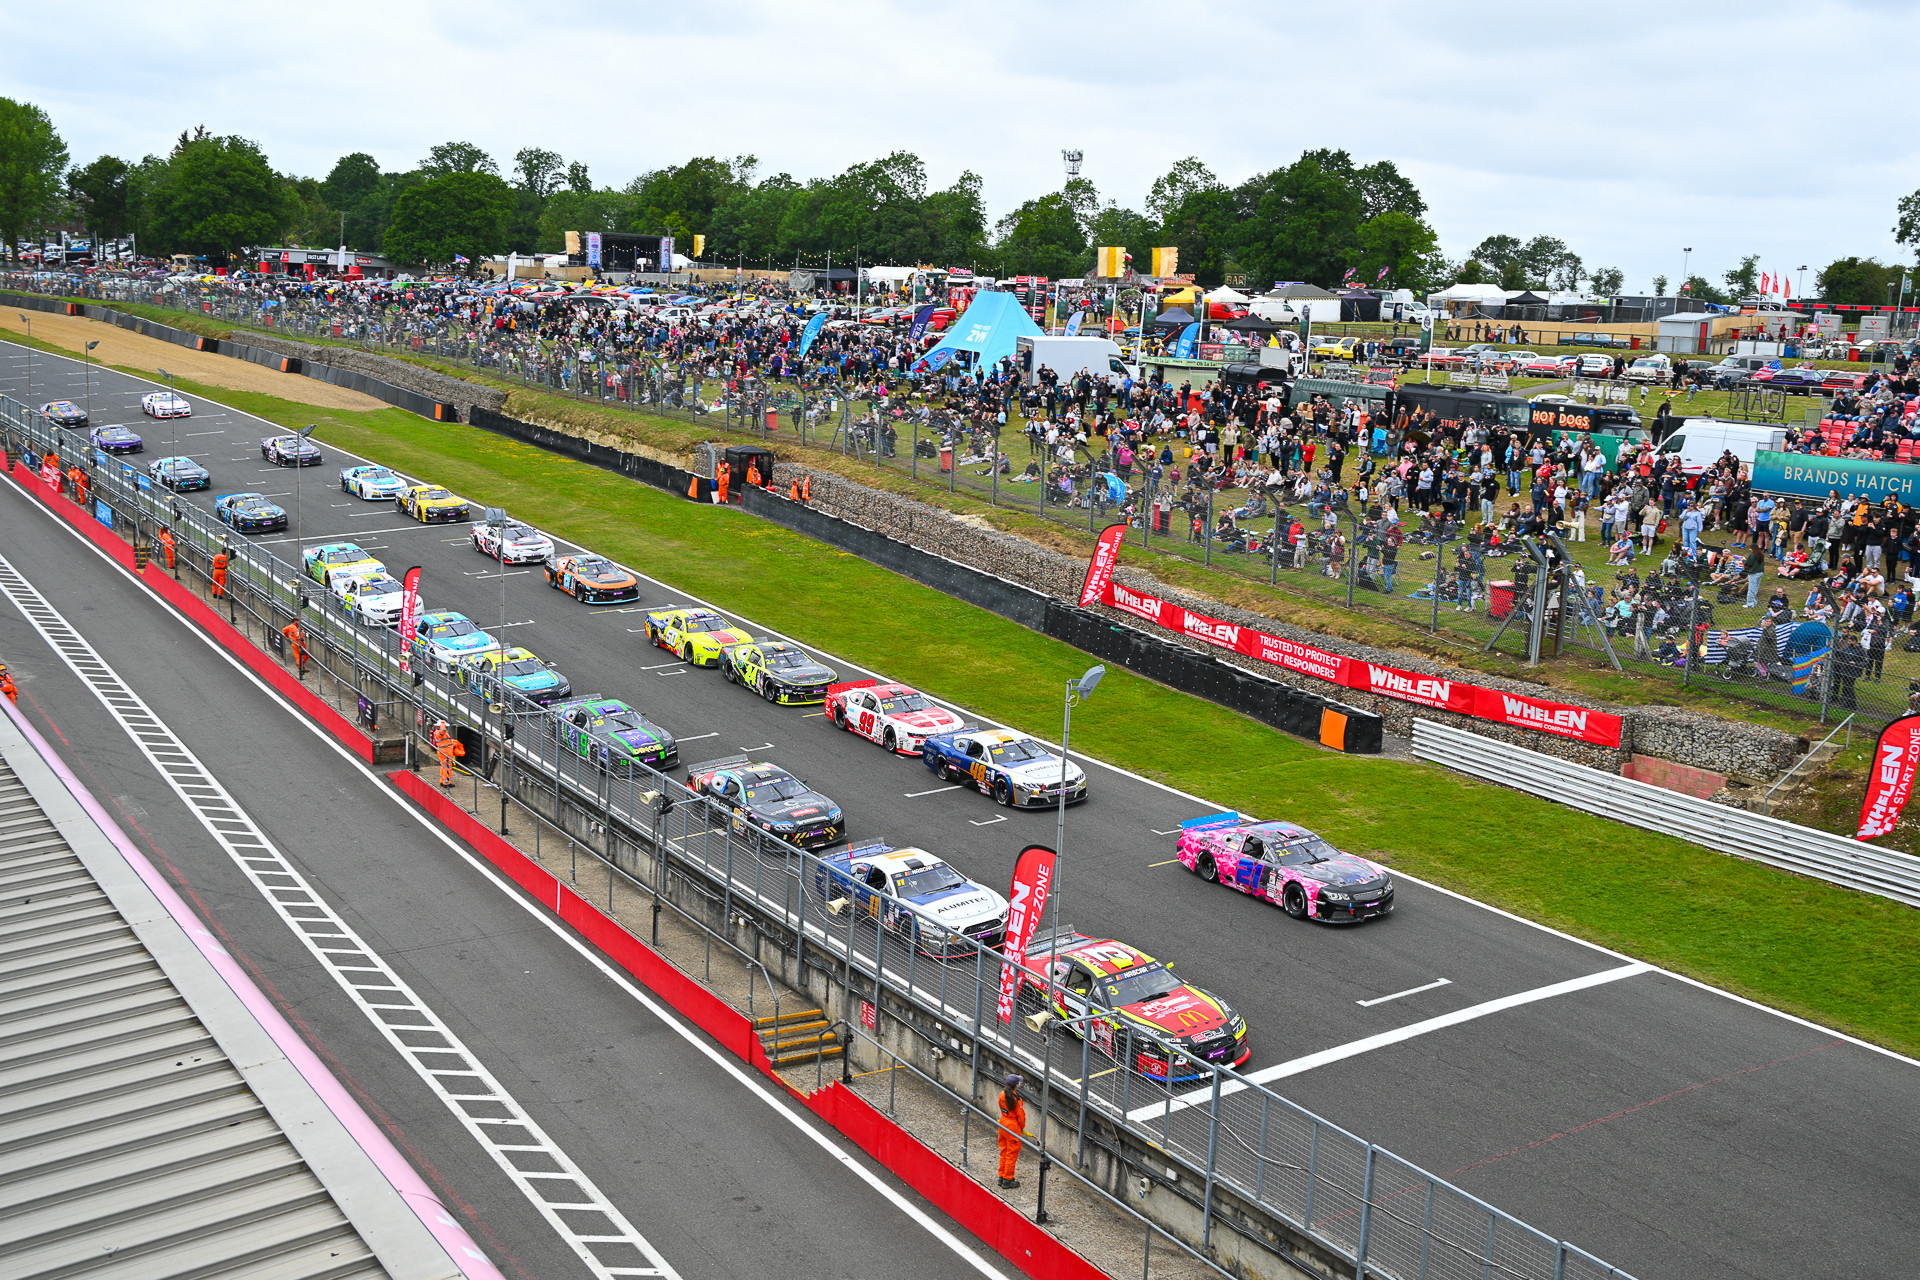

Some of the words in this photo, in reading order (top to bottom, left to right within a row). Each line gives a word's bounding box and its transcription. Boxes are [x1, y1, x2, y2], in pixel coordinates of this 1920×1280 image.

[1226, 275, 1244, 286] BAR
[966, 329, 989, 344] ZYN
[1440, 418, 1460, 429] STRE
[1532, 410, 1556, 426] HOT
[1558, 413, 1591, 430] DOGS
[1784, 466, 1849, 487] BRANDS
[1855, 473, 1913, 494] HATCH
[1102, 554, 1115, 580] START
[1112, 531, 1123, 553] ZONE
[1082, 541, 1111, 605] WHELEN
[1113, 583, 1162, 618] WHELEN
[1137, 610, 1152, 622] COMPANY
[665, 627, 679, 647] 50
[1184, 610, 1239, 645] WHELEN
[1208, 637, 1227, 649] COMPANY
[1259, 634, 1293, 653] TRUSTED
[1292, 644, 1305, 657] TO
[1304, 648, 1342, 668] PROTECT
[764, 658, 776, 666] 24
[1262, 648, 1284, 663] FIRST
[1283, 653, 1336, 679] RESPONDERS
[744, 665, 758, 686] 24
[1368, 664, 1450, 702] WHELEN
[780, 693, 789, 703] 24
[882, 702, 895, 710] 99
[1370, 685, 1407, 701] ENGINEERING
[1406, 693, 1432, 707] COMPANY
[1431, 699, 1447, 710] INC.
[593, 718, 605, 726] 19
[1502, 694, 1587, 731] WHELEN
[858, 711, 875, 735] 99
[1506, 715, 1544, 730] ENGINEERING
[1543, 722, 1573, 736] COMPANY
[1572, 729, 1584, 739] INC.
[969, 761, 987, 782] 48
[1024, 763, 1064, 774] ALUMITE
[1893, 764, 1916, 804] START
[1907, 726, 1920, 764] ZONE
[746, 790, 755, 798] 6
[1857, 743, 1904, 839] WHELEN
[1275, 848, 1292, 857] 21
[911, 864, 934, 876] NASCAR
[1236, 857, 1265, 891] 21
[896, 878, 905, 887] 11
[1033, 863, 1050, 910] ZONE
[937, 896, 988, 915] ALUMITEC
[1123, 966, 1149, 980] NASCAR
[1107, 985, 1119, 996] 3
